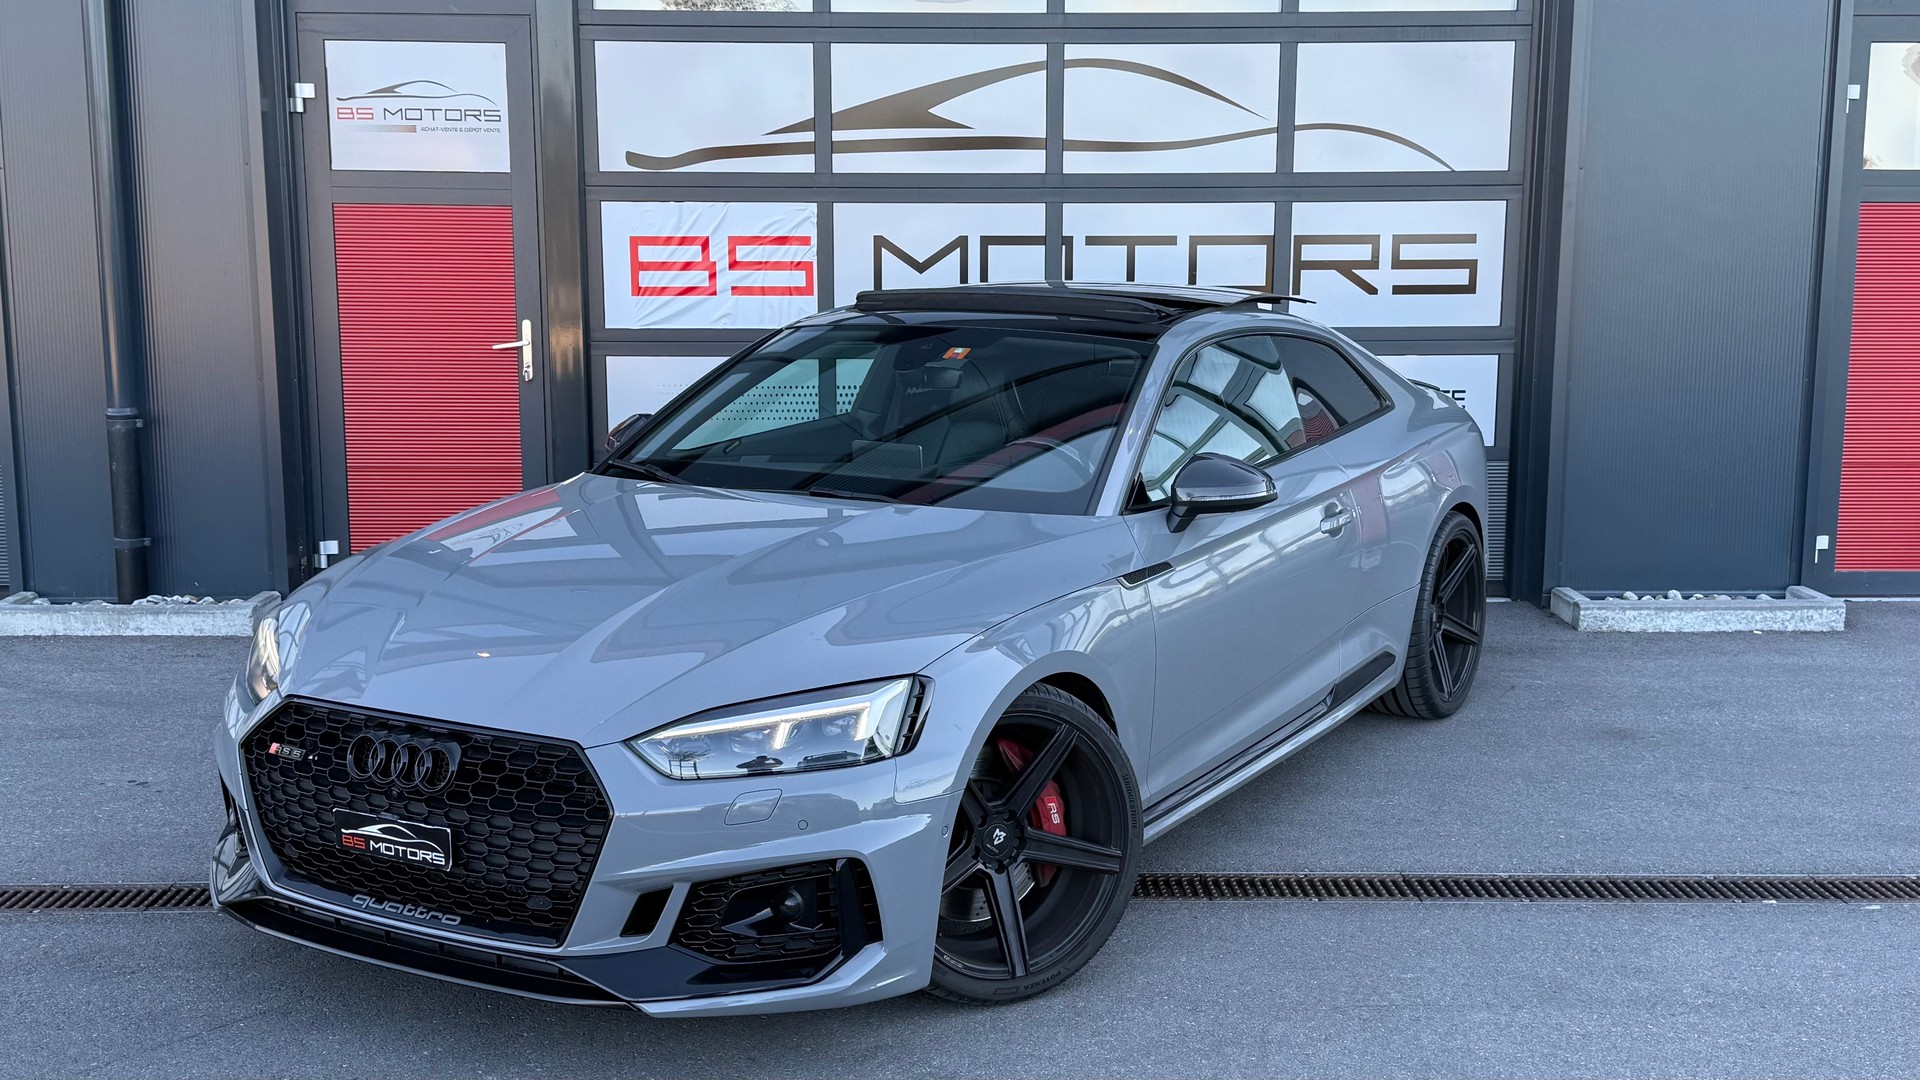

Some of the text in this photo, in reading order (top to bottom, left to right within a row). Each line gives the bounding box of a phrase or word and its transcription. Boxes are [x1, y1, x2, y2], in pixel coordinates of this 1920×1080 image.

[336, 107, 502, 122] BS MOTORS
[629, 234, 1478, 296] BS MOTORS
[1047, 802, 1060, 824] RS
[342, 834, 445, 865] BS MOTORS
[352, 893, 462, 926] quattro
